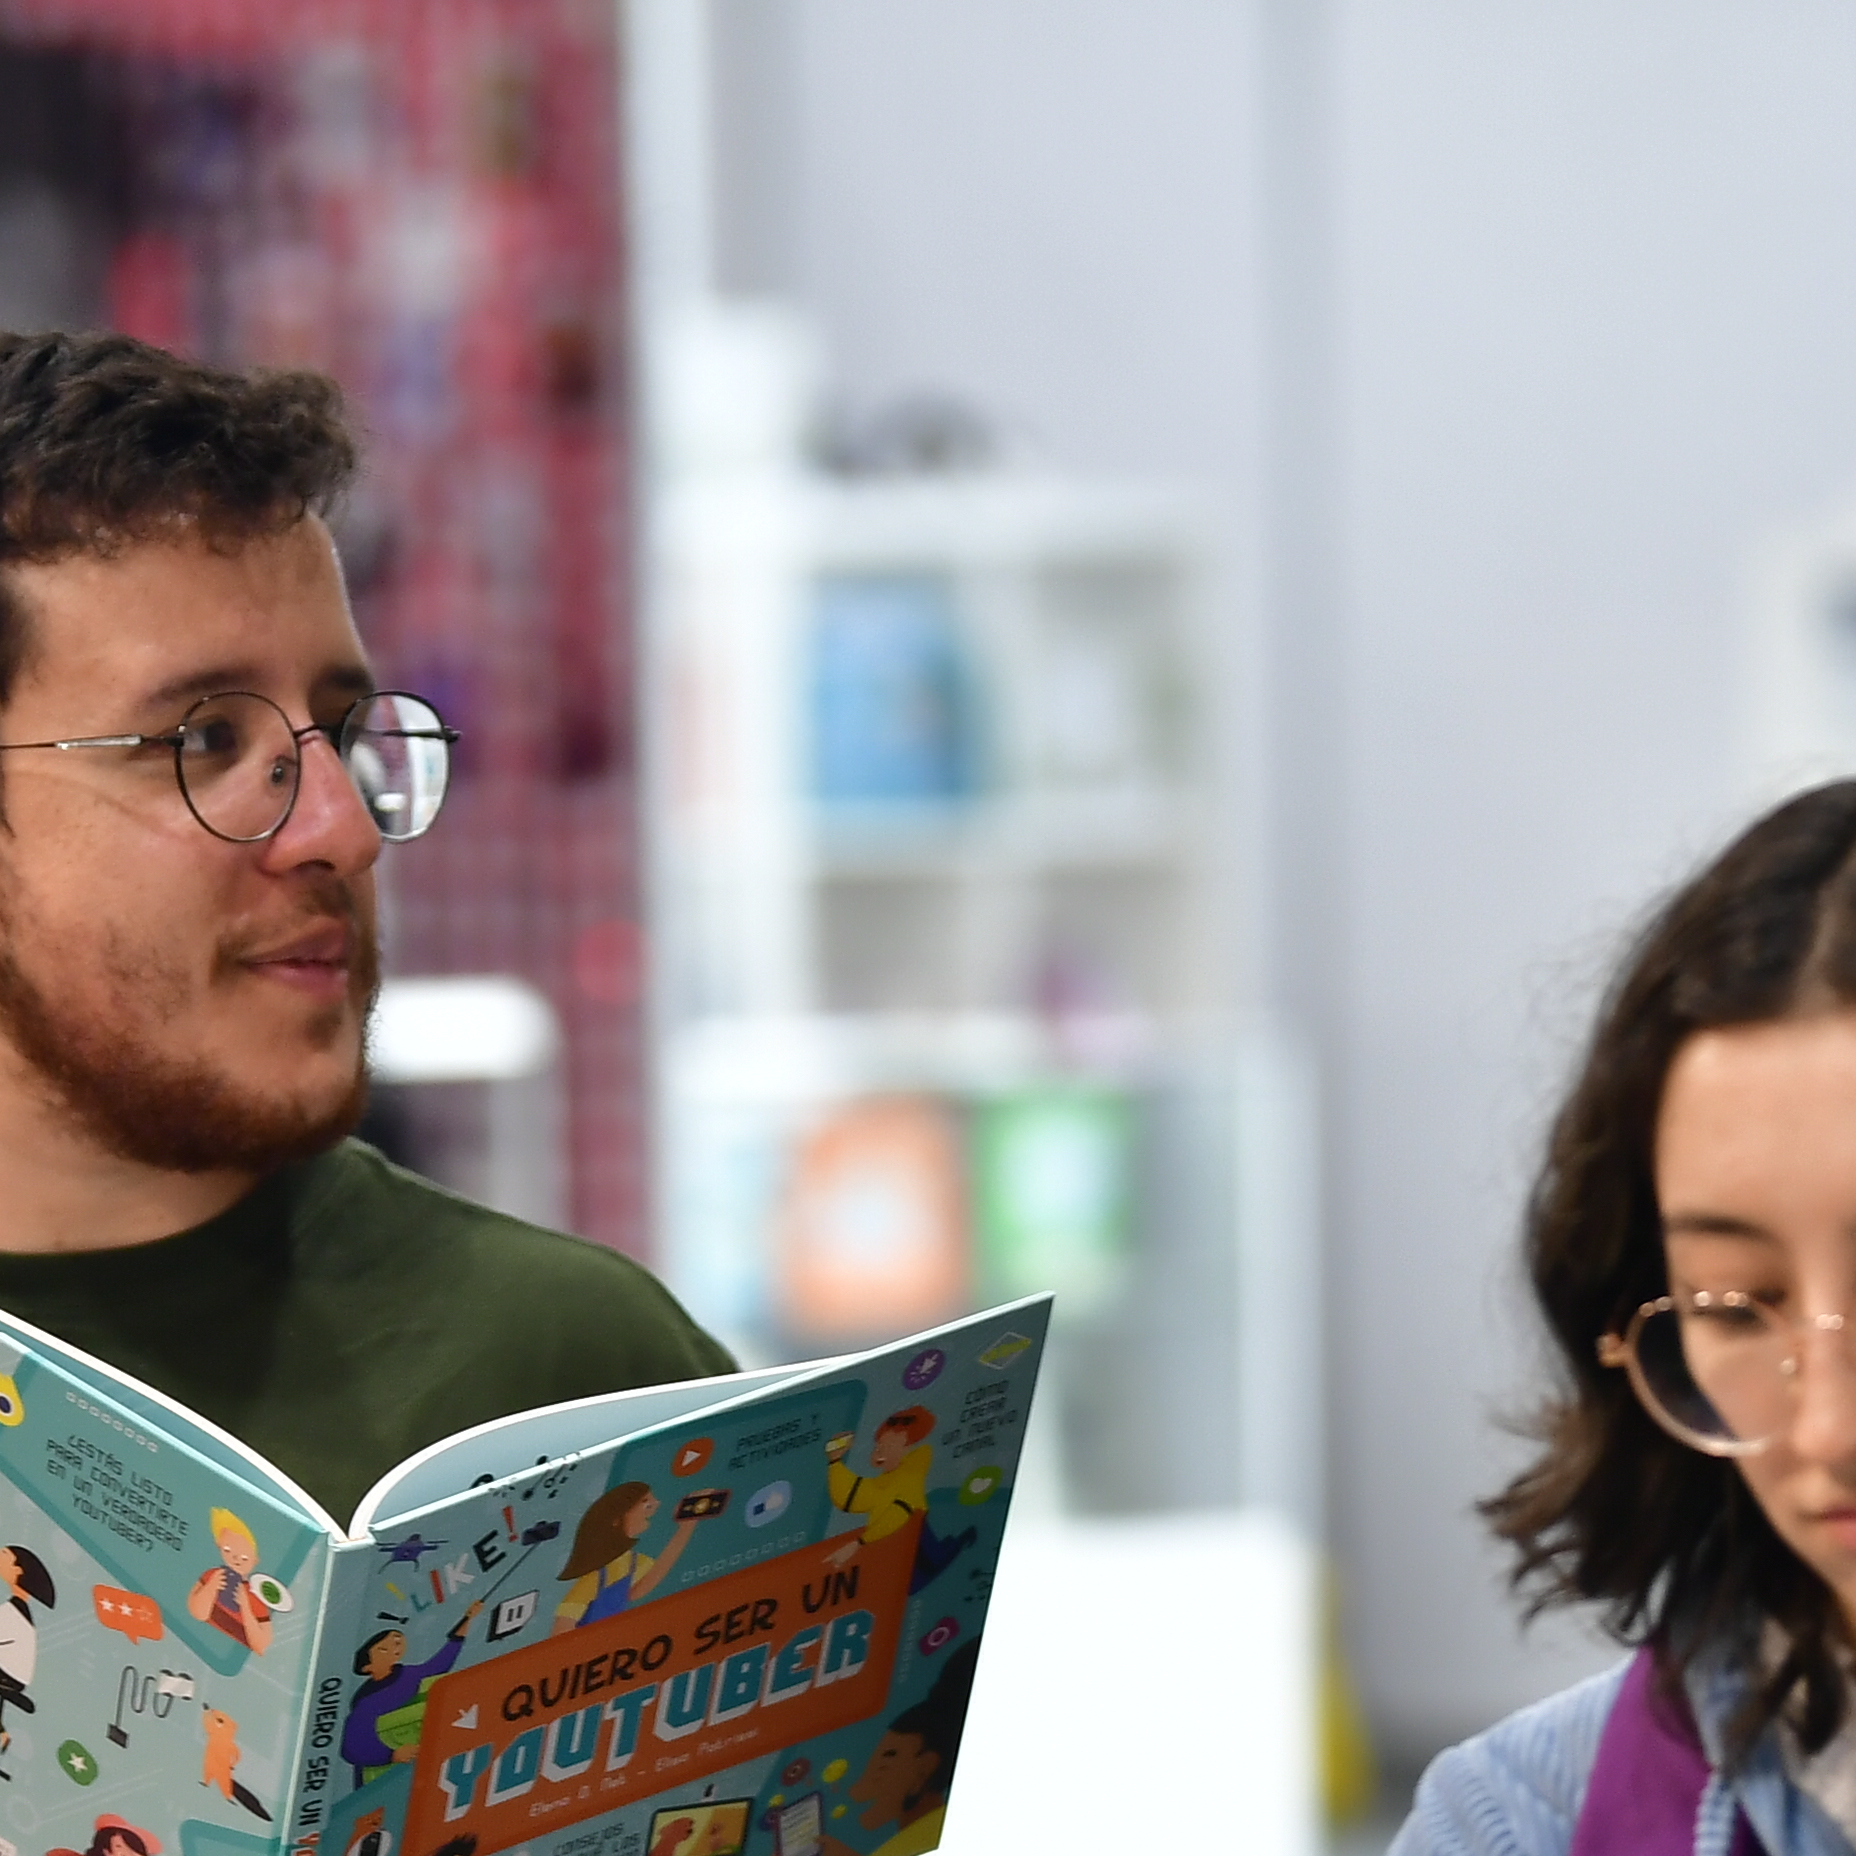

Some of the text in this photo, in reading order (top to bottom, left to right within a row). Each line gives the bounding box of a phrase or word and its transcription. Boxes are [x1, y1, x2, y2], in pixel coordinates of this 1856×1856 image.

[47, 1439, 189, 1536] PARA CONVERTIRTE
[47, 1459, 183, 1551] EN UN VERDADERO
[73, 1494, 153, 1552] YOUTUBER?
[131, 1472, 172, 1506] LISTO
[502, 1565, 859, 1723] QUIERO SER UN
[312, 1677, 342, 1749] QUIERO
[438, 1609, 875, 1822] YOUTUBER
[303, 1756, 330, 1792] SER
[298, 1800, 322, 1826] UN
